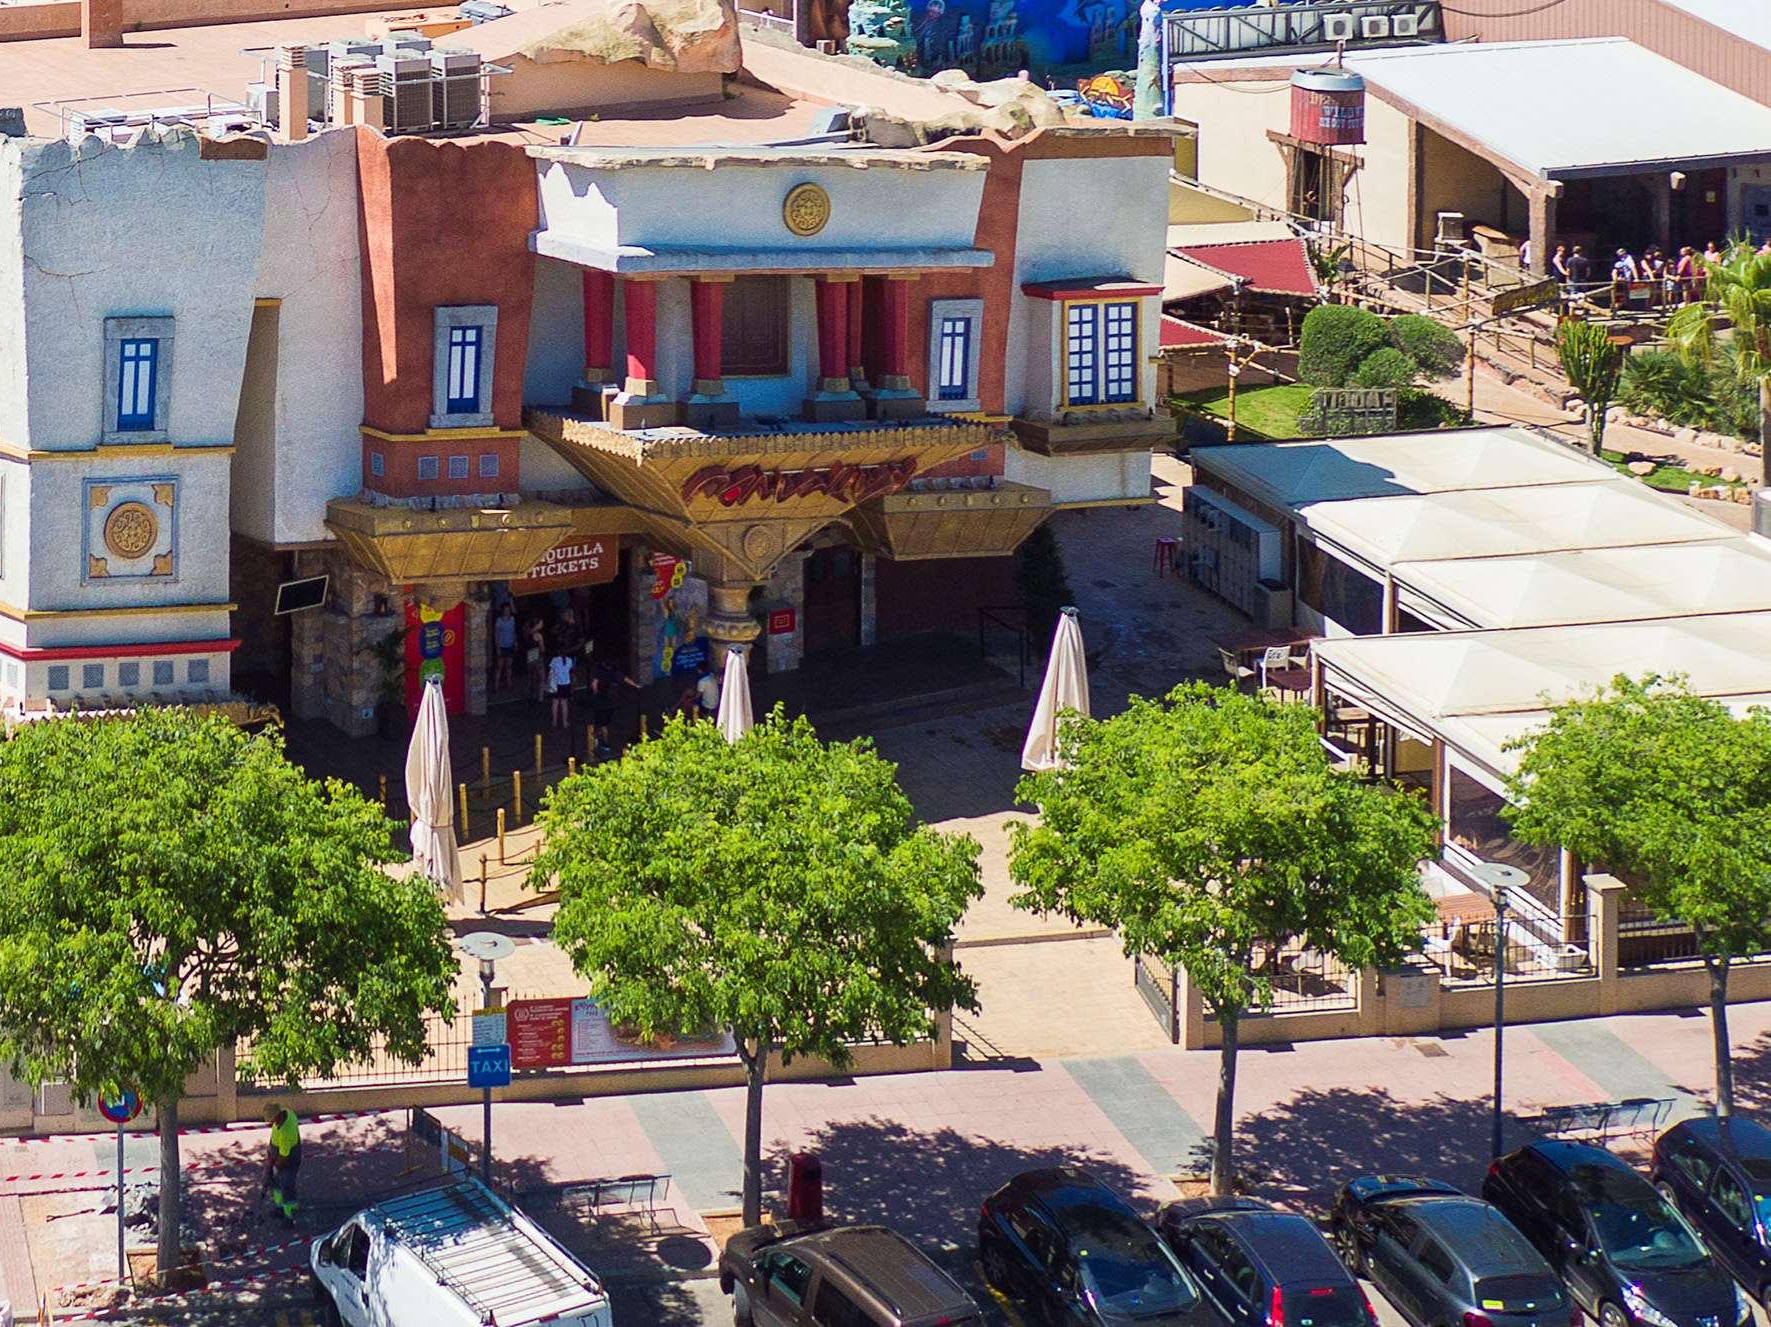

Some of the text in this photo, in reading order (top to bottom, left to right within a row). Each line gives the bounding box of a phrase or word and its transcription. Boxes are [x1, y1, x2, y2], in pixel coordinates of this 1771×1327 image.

[539, 542, 605, 564] QUILLA
[531, 557, 599, 578] TICKETS
[470, 1059, 509, 1073] TAXI
